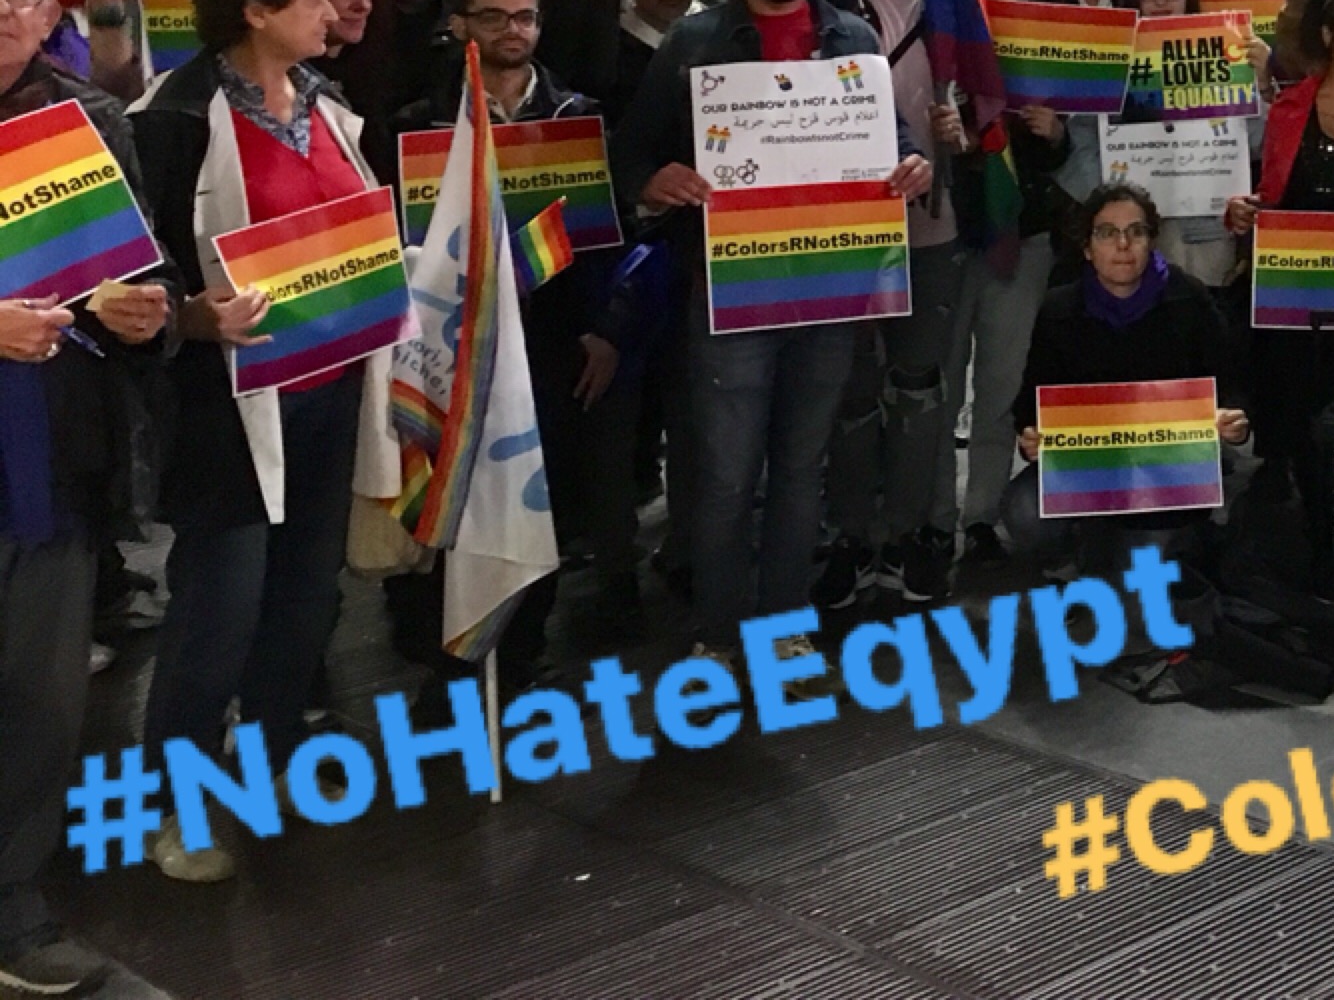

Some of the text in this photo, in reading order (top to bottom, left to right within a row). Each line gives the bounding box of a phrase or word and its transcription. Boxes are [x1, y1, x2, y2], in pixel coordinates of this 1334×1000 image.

[993, 41, 1130, 61] ColorsRNotShame
[1162, 36, 1224, 60] ALLAH
[1162, 59, 1231, 86] LOVES
[702, 94, 877, 114] OUR RAINBOW IS NOT A CRIME
[1163, 84, 1253, 110] EQUALITY
[712, 229, 904, 257] #ColorsRNotShame
[1043, 428, 1215, 447] #ColorsRNotShame
